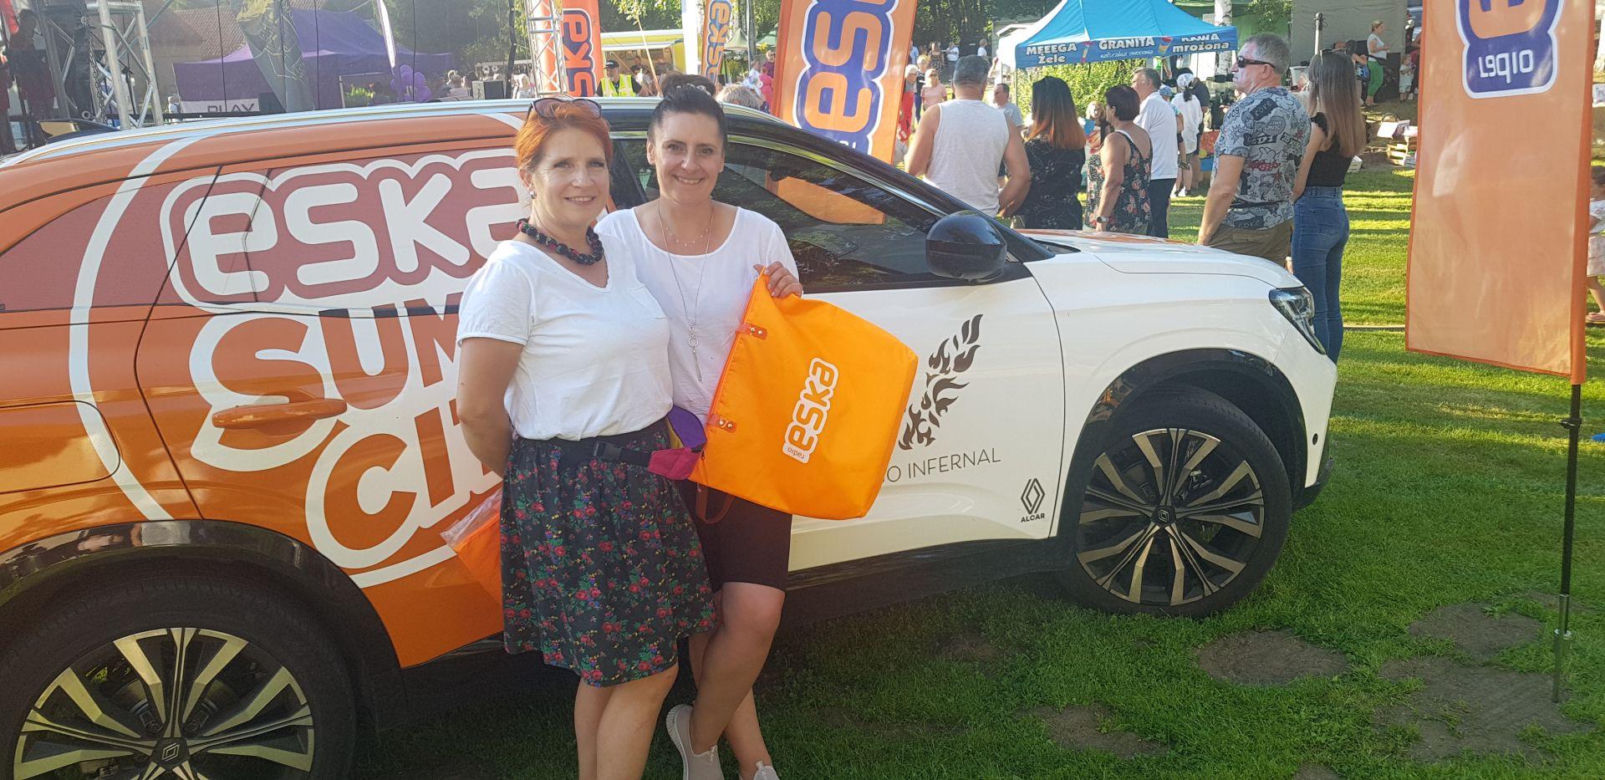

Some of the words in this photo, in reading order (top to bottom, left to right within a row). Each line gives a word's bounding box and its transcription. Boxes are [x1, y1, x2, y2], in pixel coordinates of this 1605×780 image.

[805, 0, 885, 133] es
[1099, 37, 1155, 50] GRANITA
[788, 361, 836, 452] eska
[323, 398, 495, 551] CI
[908, 448, 1001, 479] INFERNAL
[1020, 513, 1046, 523] ALCAR
